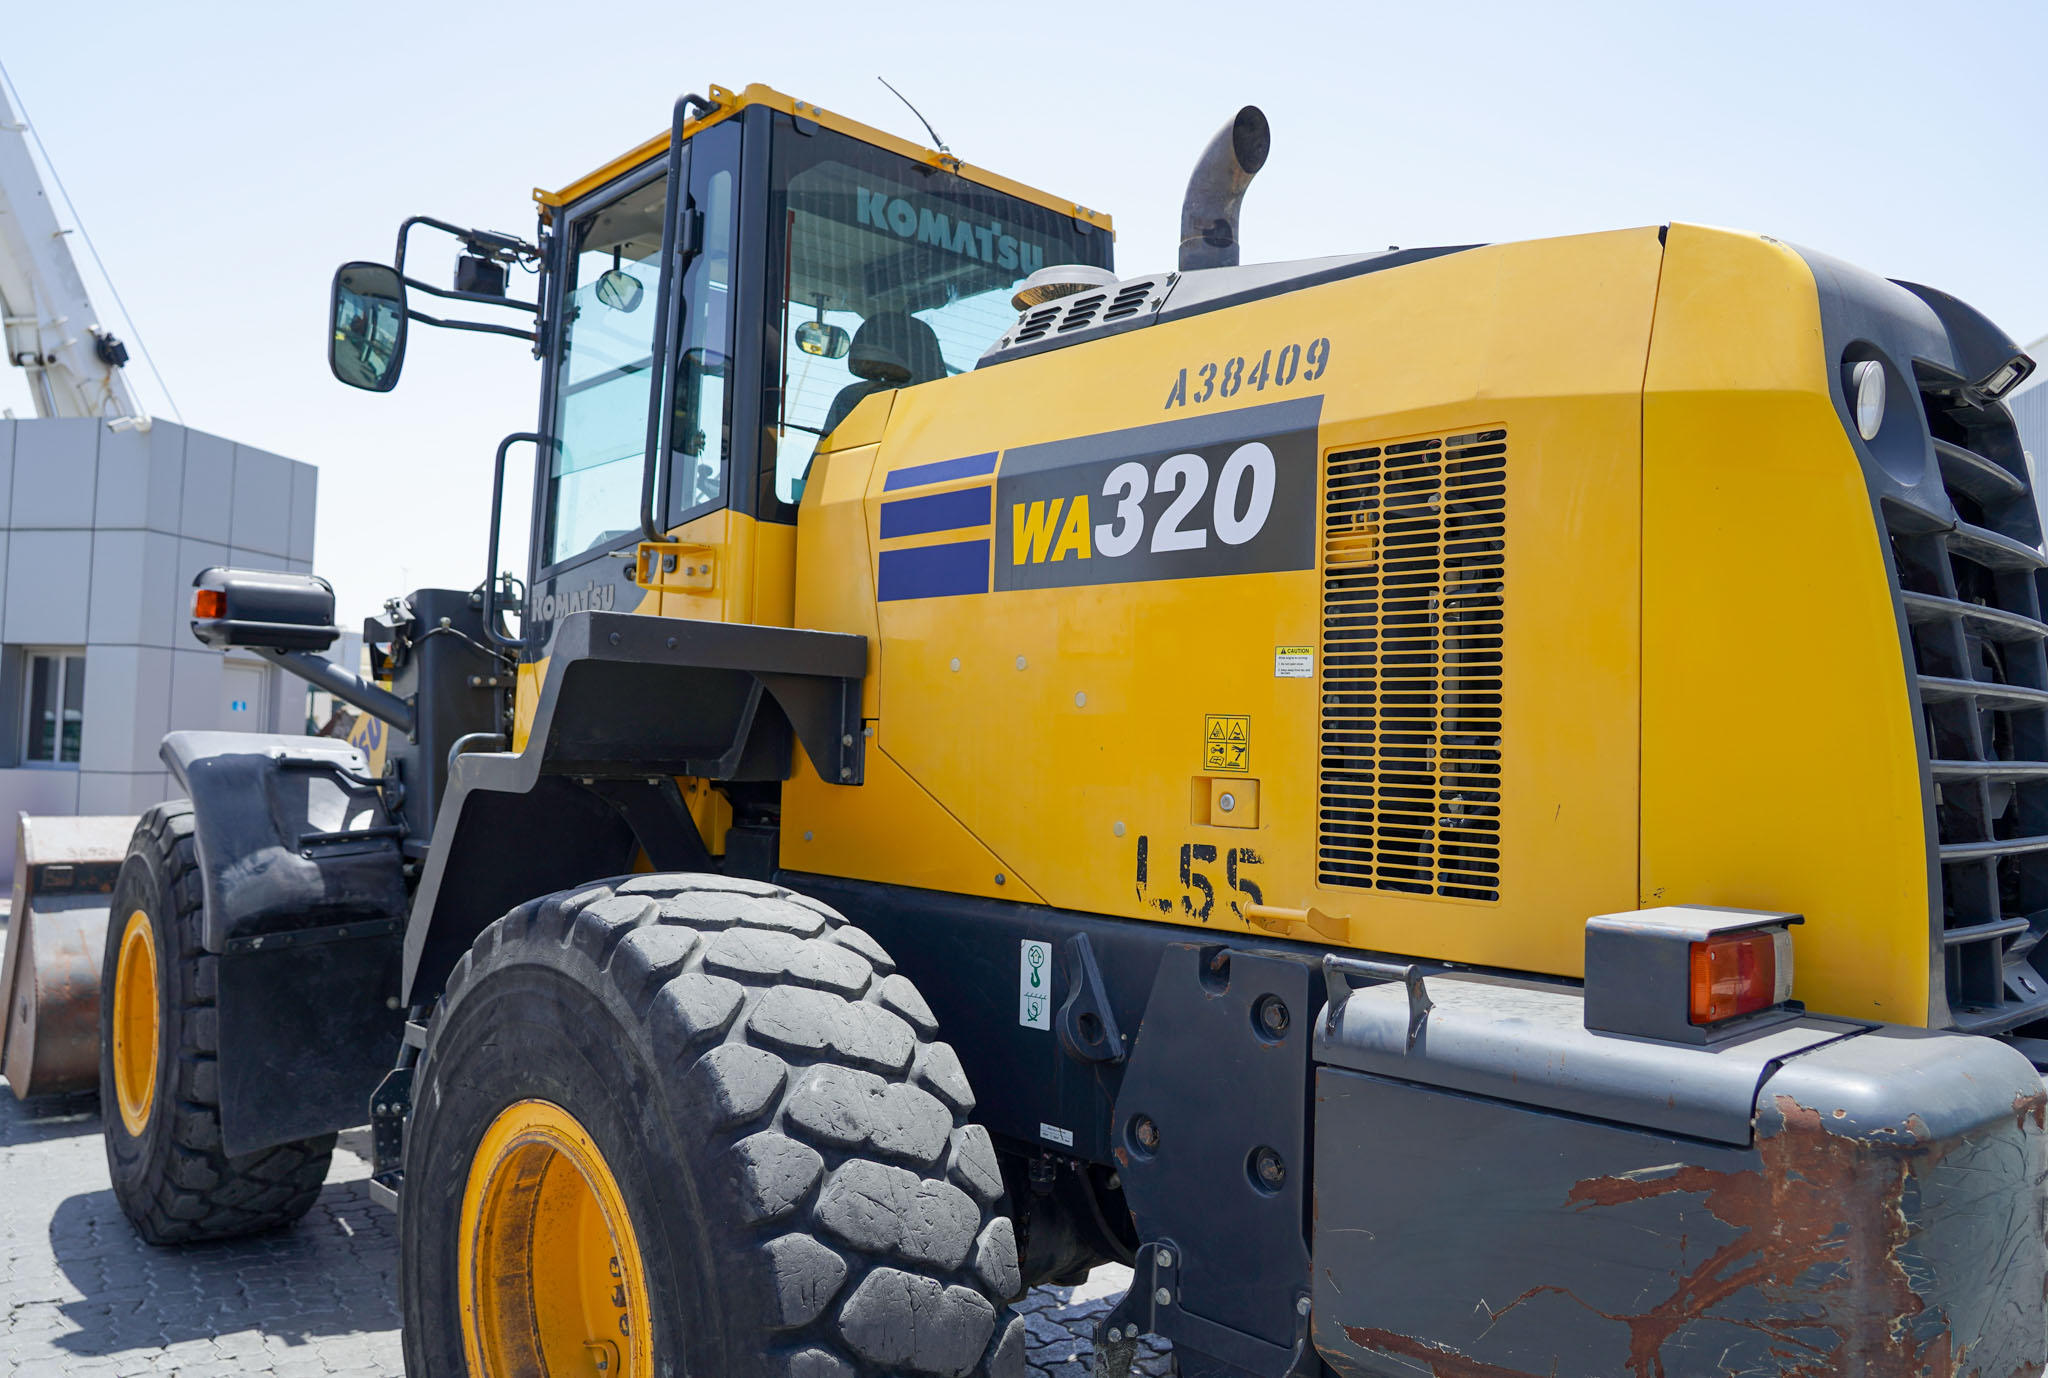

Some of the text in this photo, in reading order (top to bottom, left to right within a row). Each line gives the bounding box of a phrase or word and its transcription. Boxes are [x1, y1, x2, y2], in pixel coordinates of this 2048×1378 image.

[857, 186, 1043, 276] KOMATSU
[1164, 337, 1331, 410] A38409
[532, 580, 615, 622] KOMATSU
